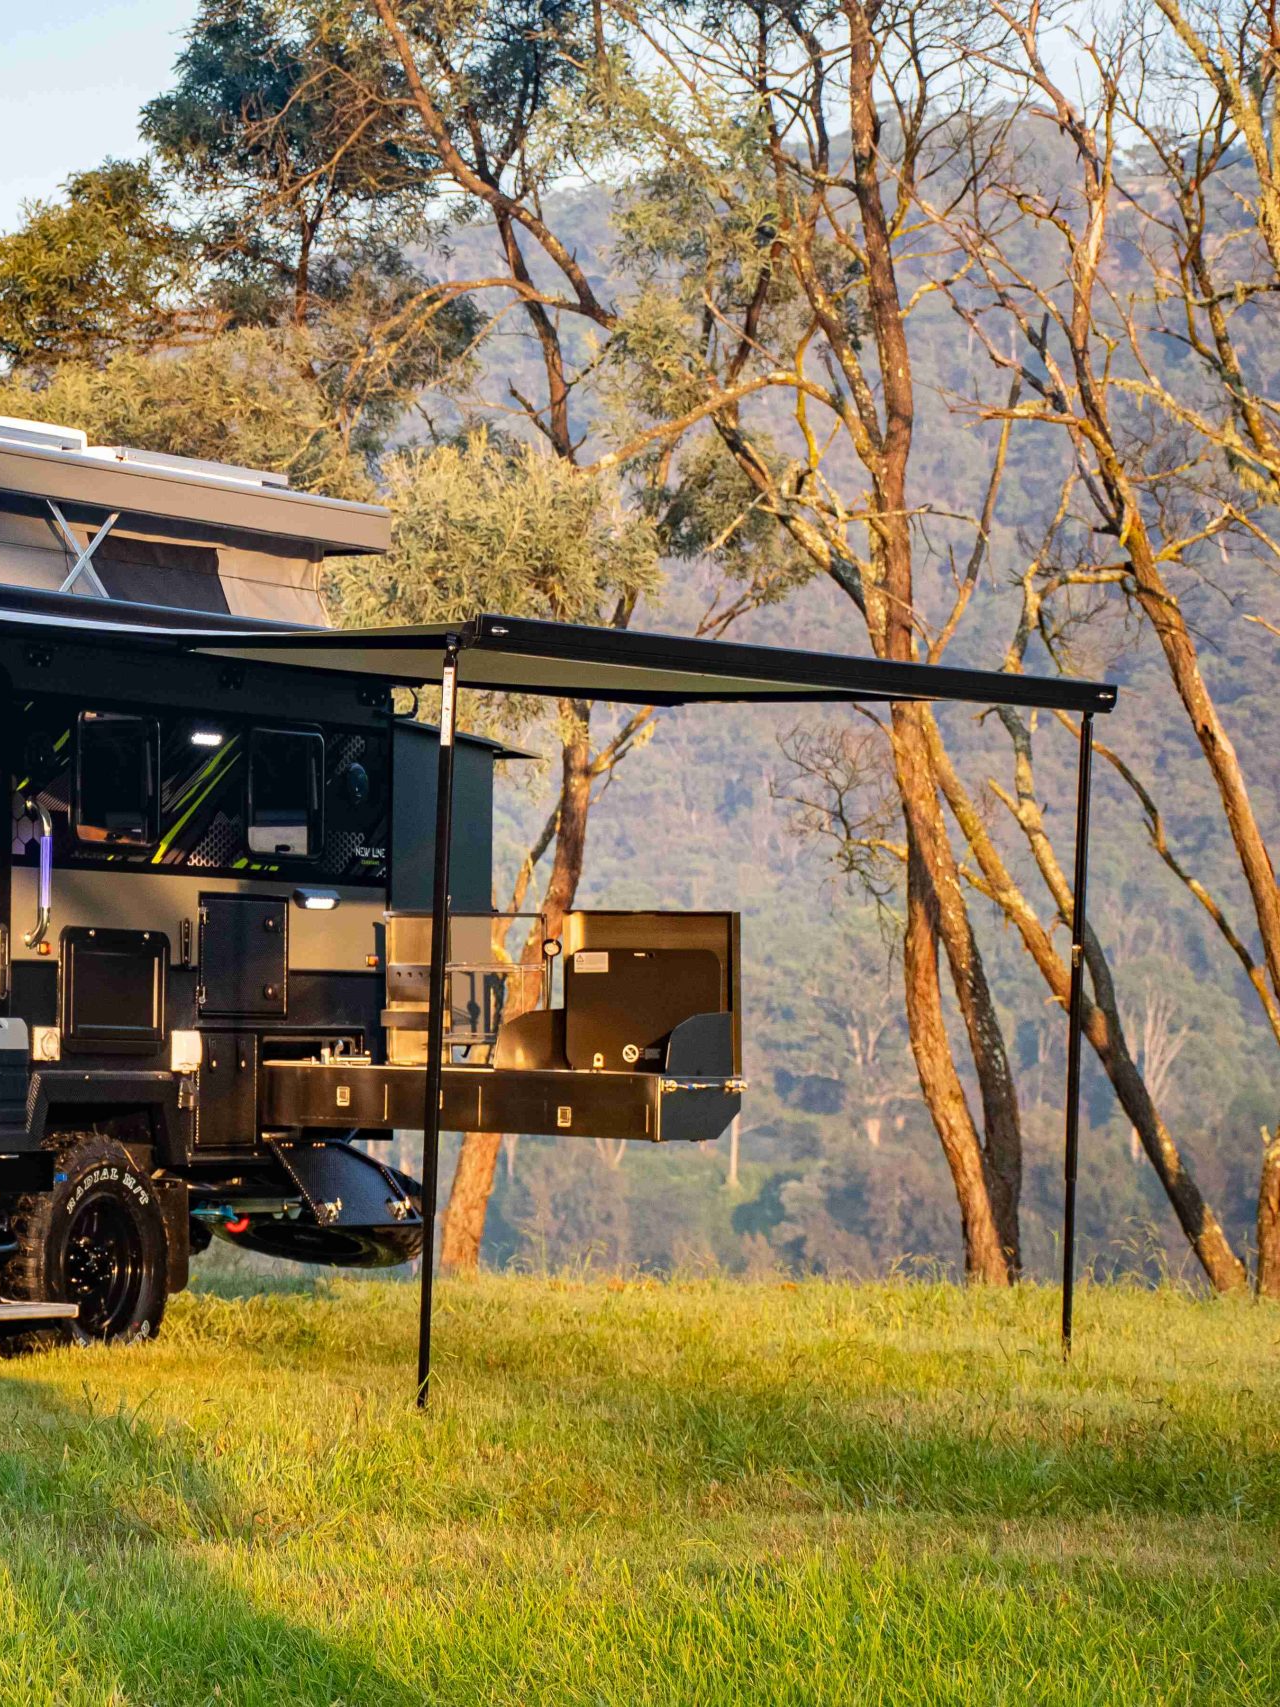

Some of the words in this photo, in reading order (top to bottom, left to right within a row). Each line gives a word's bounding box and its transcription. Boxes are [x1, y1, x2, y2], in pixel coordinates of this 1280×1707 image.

[355, 846, 371, 858] NEW
[66, 1167, 119, 1215] RADIAL
[122, 1172, 150, 1206] M/T
